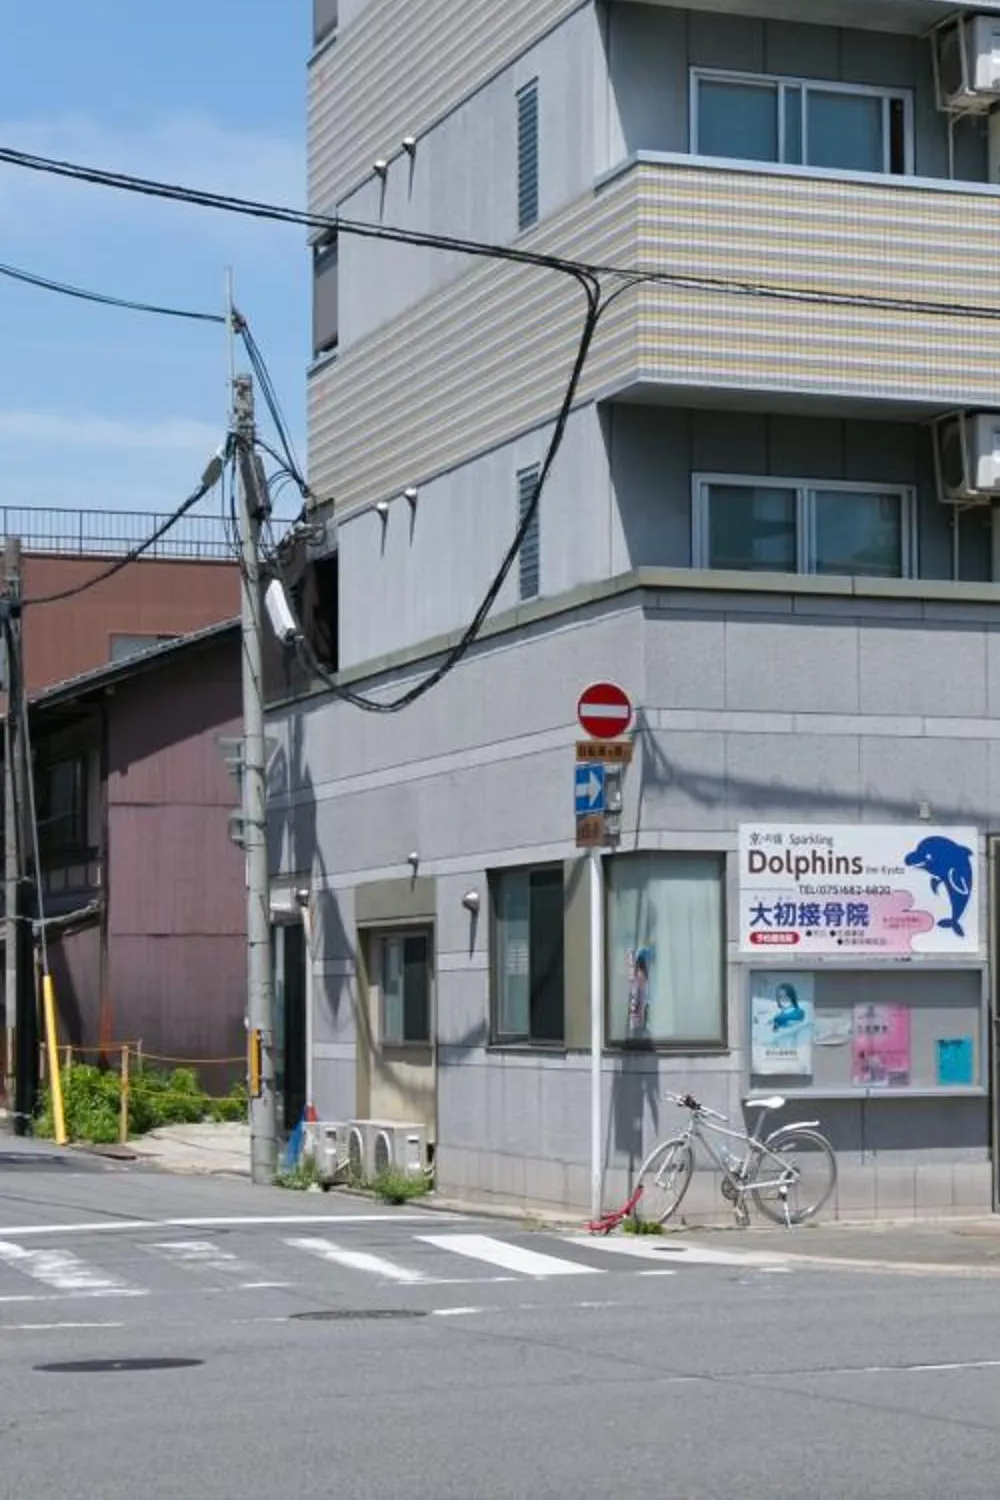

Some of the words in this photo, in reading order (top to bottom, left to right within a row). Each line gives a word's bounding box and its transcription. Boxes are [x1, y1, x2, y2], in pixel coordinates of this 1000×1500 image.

[789, 832, 834, 848] Sparkling
[748, 849, 864, 881] Dolphins
[749, 902, 870, 927] 大初接骨院
